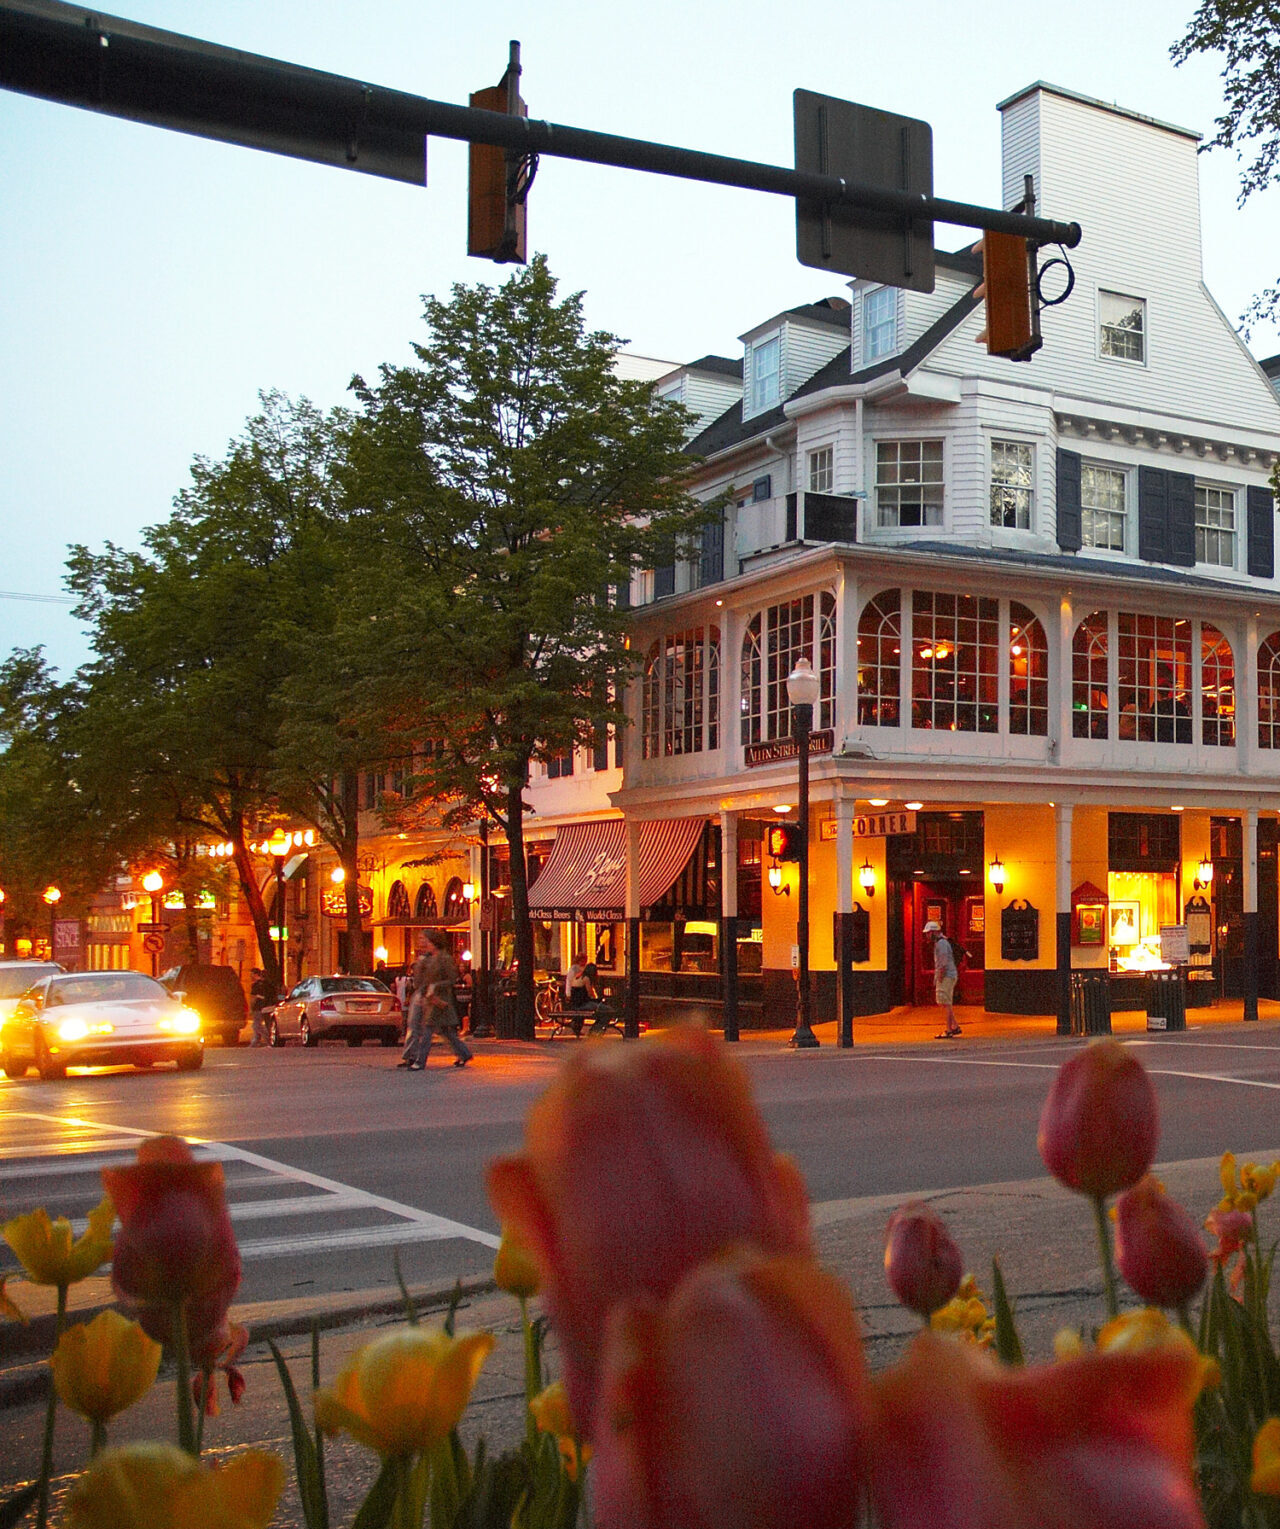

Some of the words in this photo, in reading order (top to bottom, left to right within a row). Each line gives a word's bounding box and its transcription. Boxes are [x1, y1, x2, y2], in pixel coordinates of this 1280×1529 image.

[852, 815, 906, 835] ORNER
[553, 910, 571, 919] Beers
[586, 909, 623, 920] World-Class
